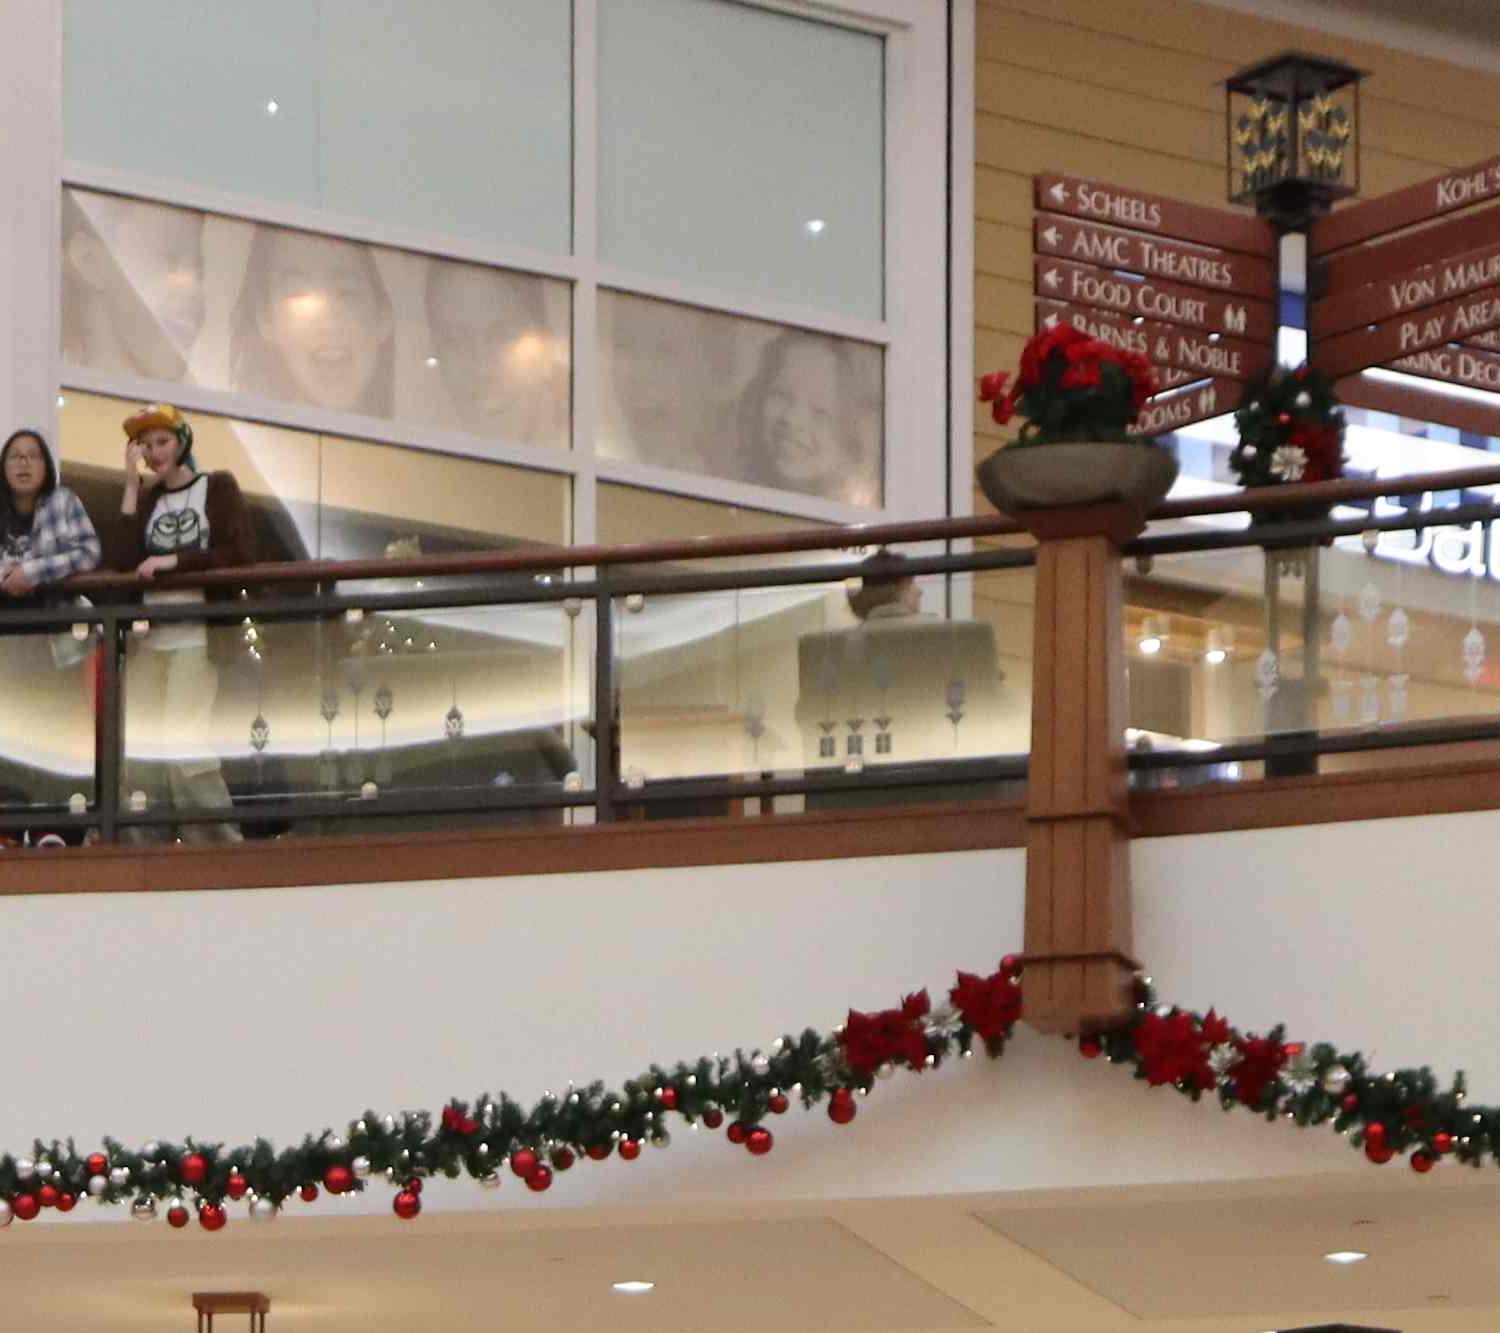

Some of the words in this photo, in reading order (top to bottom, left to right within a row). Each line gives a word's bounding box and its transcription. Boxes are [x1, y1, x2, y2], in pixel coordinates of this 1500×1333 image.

[1076, 184, 1161, 227] SCHEELS
[1071, 229, 1130, 266] AMC
[1140, 241, 1233, 288] THEATRES
[1072, 269, 1131, 306] FOOD
[1137, 285, 1207, 323] COURT
[1389, 278, 1436, 310] VON
[1400, 316, 1446, 350] PLAY
[1155, 337, 1170, 360] &
[1179, 337, 1241, 375] NOBLE
